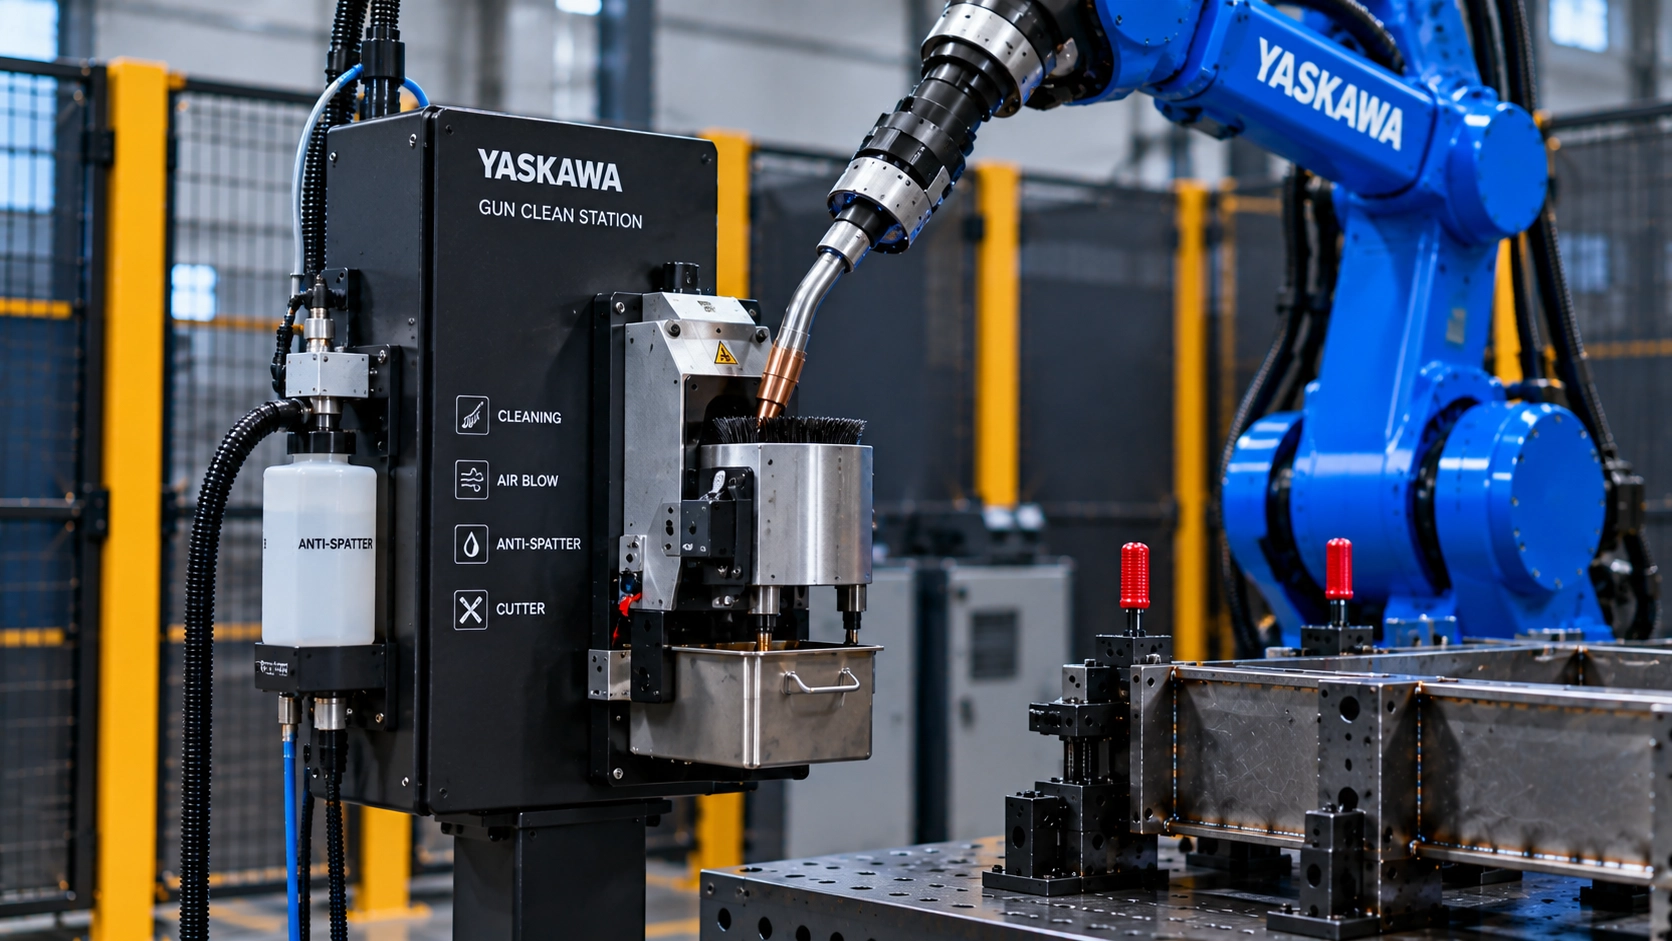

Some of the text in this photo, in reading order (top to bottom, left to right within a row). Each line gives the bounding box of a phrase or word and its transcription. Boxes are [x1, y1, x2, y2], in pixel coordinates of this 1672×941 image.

[1256, 36, 1403, 152] YASKAWA
[477, 148, 623, 193] YASKAWA
[479, 199, 643, 230] GUN CLEAN STATION
[497, 409, 562, 425] CLEANING
[496, 473, 559, 487] AIR BLOW
[298, 537, 373, 550] ANTI-SPATTER
[496, 537, 581, 551] ANTI-SPATTER
[496, 602, 546, 616] CUTTER
